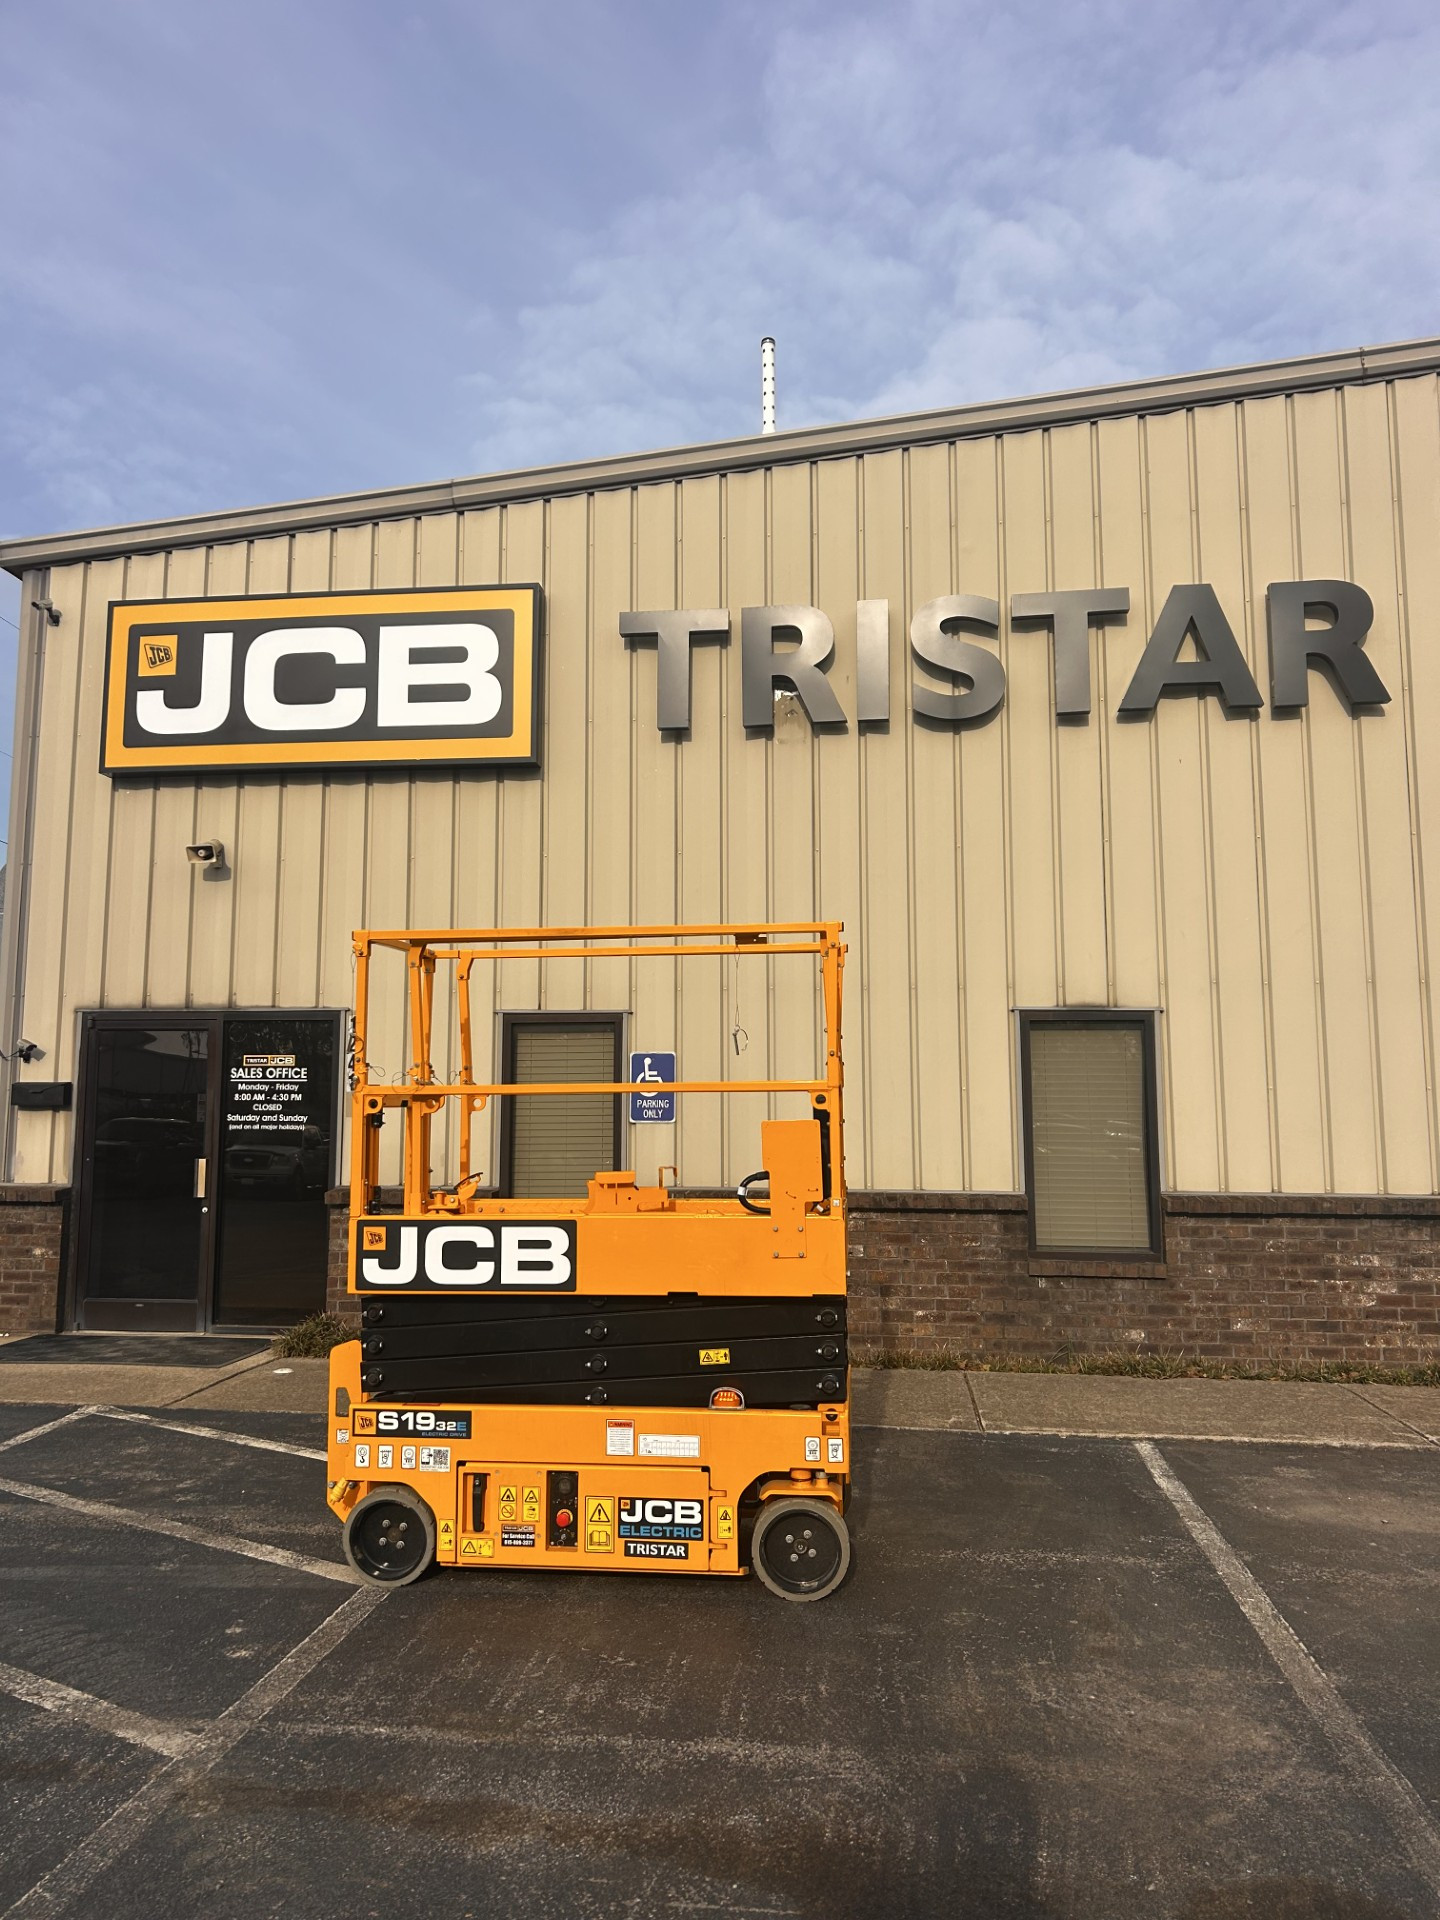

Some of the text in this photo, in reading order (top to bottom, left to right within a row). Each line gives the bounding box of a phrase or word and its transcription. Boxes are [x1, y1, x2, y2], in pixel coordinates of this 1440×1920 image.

[149, 646, 171, 666] JCB
[619, 579, 1392, 732] TRISTAR
[136, 623, 502, 735] JCB
[230, 1067, 308, 1079] SALES OFFICE
[237, 1083, 270, 1092] Monday
[275, 1083, 299, 1092] Friday
[234, 1093, 251, 1101] 8:00
[252, 1093, 265, 1101] AM
[271, 1093, 289, 1101] 4:30
[290, 1093, 302, 1101] PM
[636, 1099, 670, 1108] PARKING
[252, 1103, 282, 1111] CLOSED
[643, 1109, 663, 1118] ONLY
[227, 1113, 308, 1123] Saturday and Sunday
[369, 1229, 384, 1244] JCB
[362, 1226, 572, 1285] JCB
[620, 1499, 702, 1525] JCB
[619, 1524, 702, 1538] ELECTRIC
[627, 1543, 686, 1557] TRISTAR
